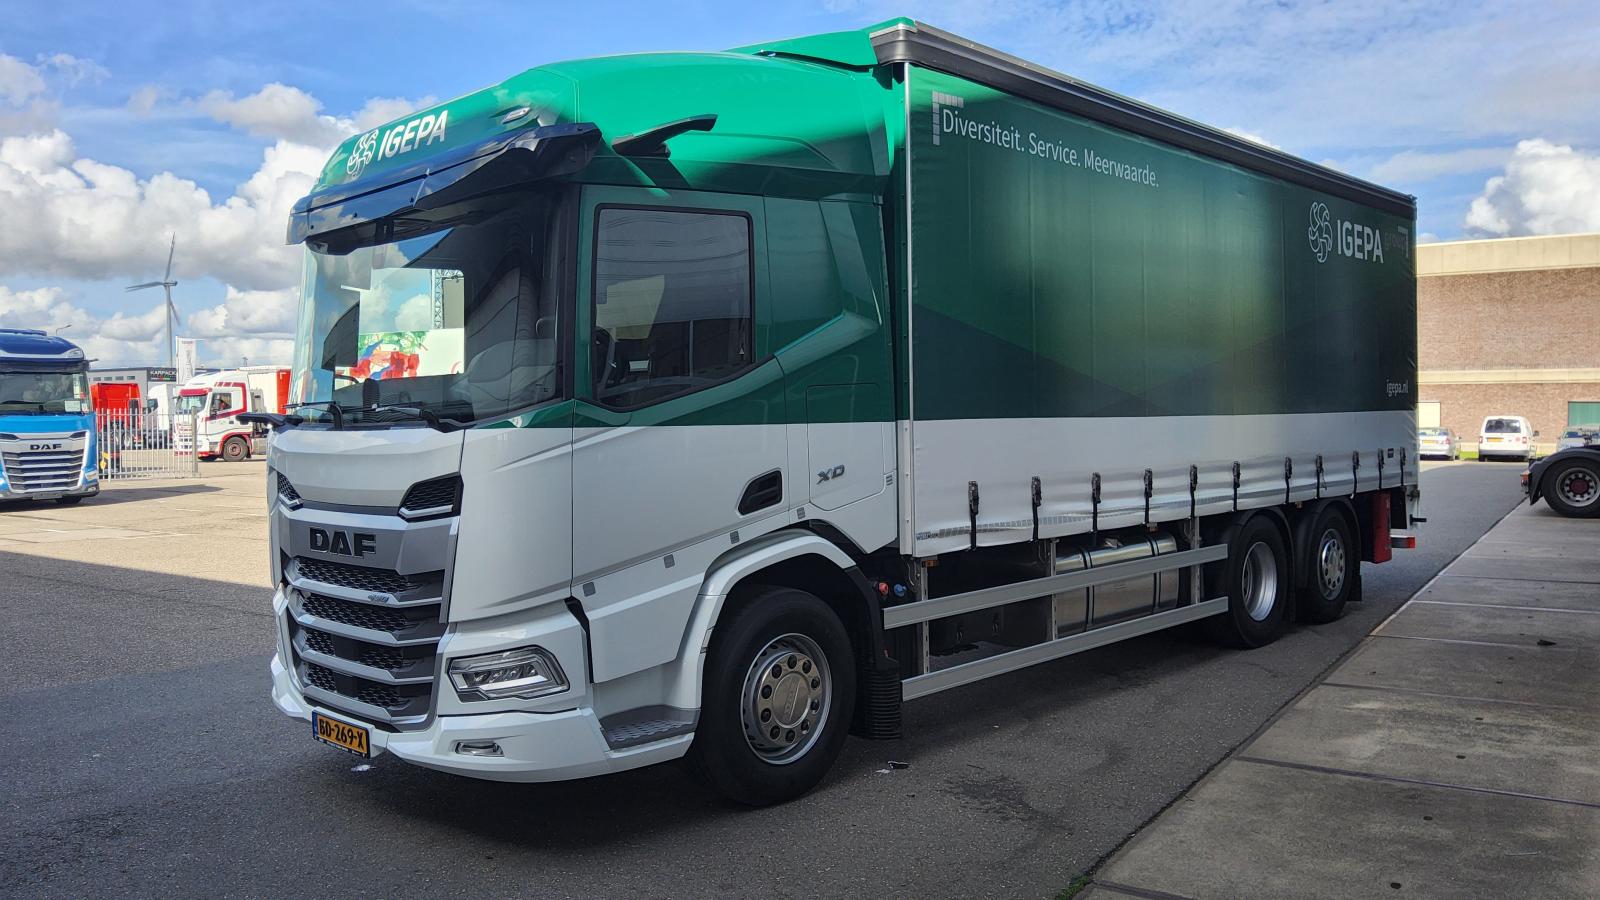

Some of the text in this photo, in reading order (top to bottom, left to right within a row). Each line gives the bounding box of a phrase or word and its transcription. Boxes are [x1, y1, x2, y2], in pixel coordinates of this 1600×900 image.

[376, 110, 447, 161] IGEPA
[943, 109, 1159, 188] Diversiteit. Service. Meerwaarde.
[1337, 219, 1384, 263] IGEPA
[1386, 379, 1408, 397] igepa.nl
[816, 465, 845, 484] XD
[309, 527, 377, 558] DAF
